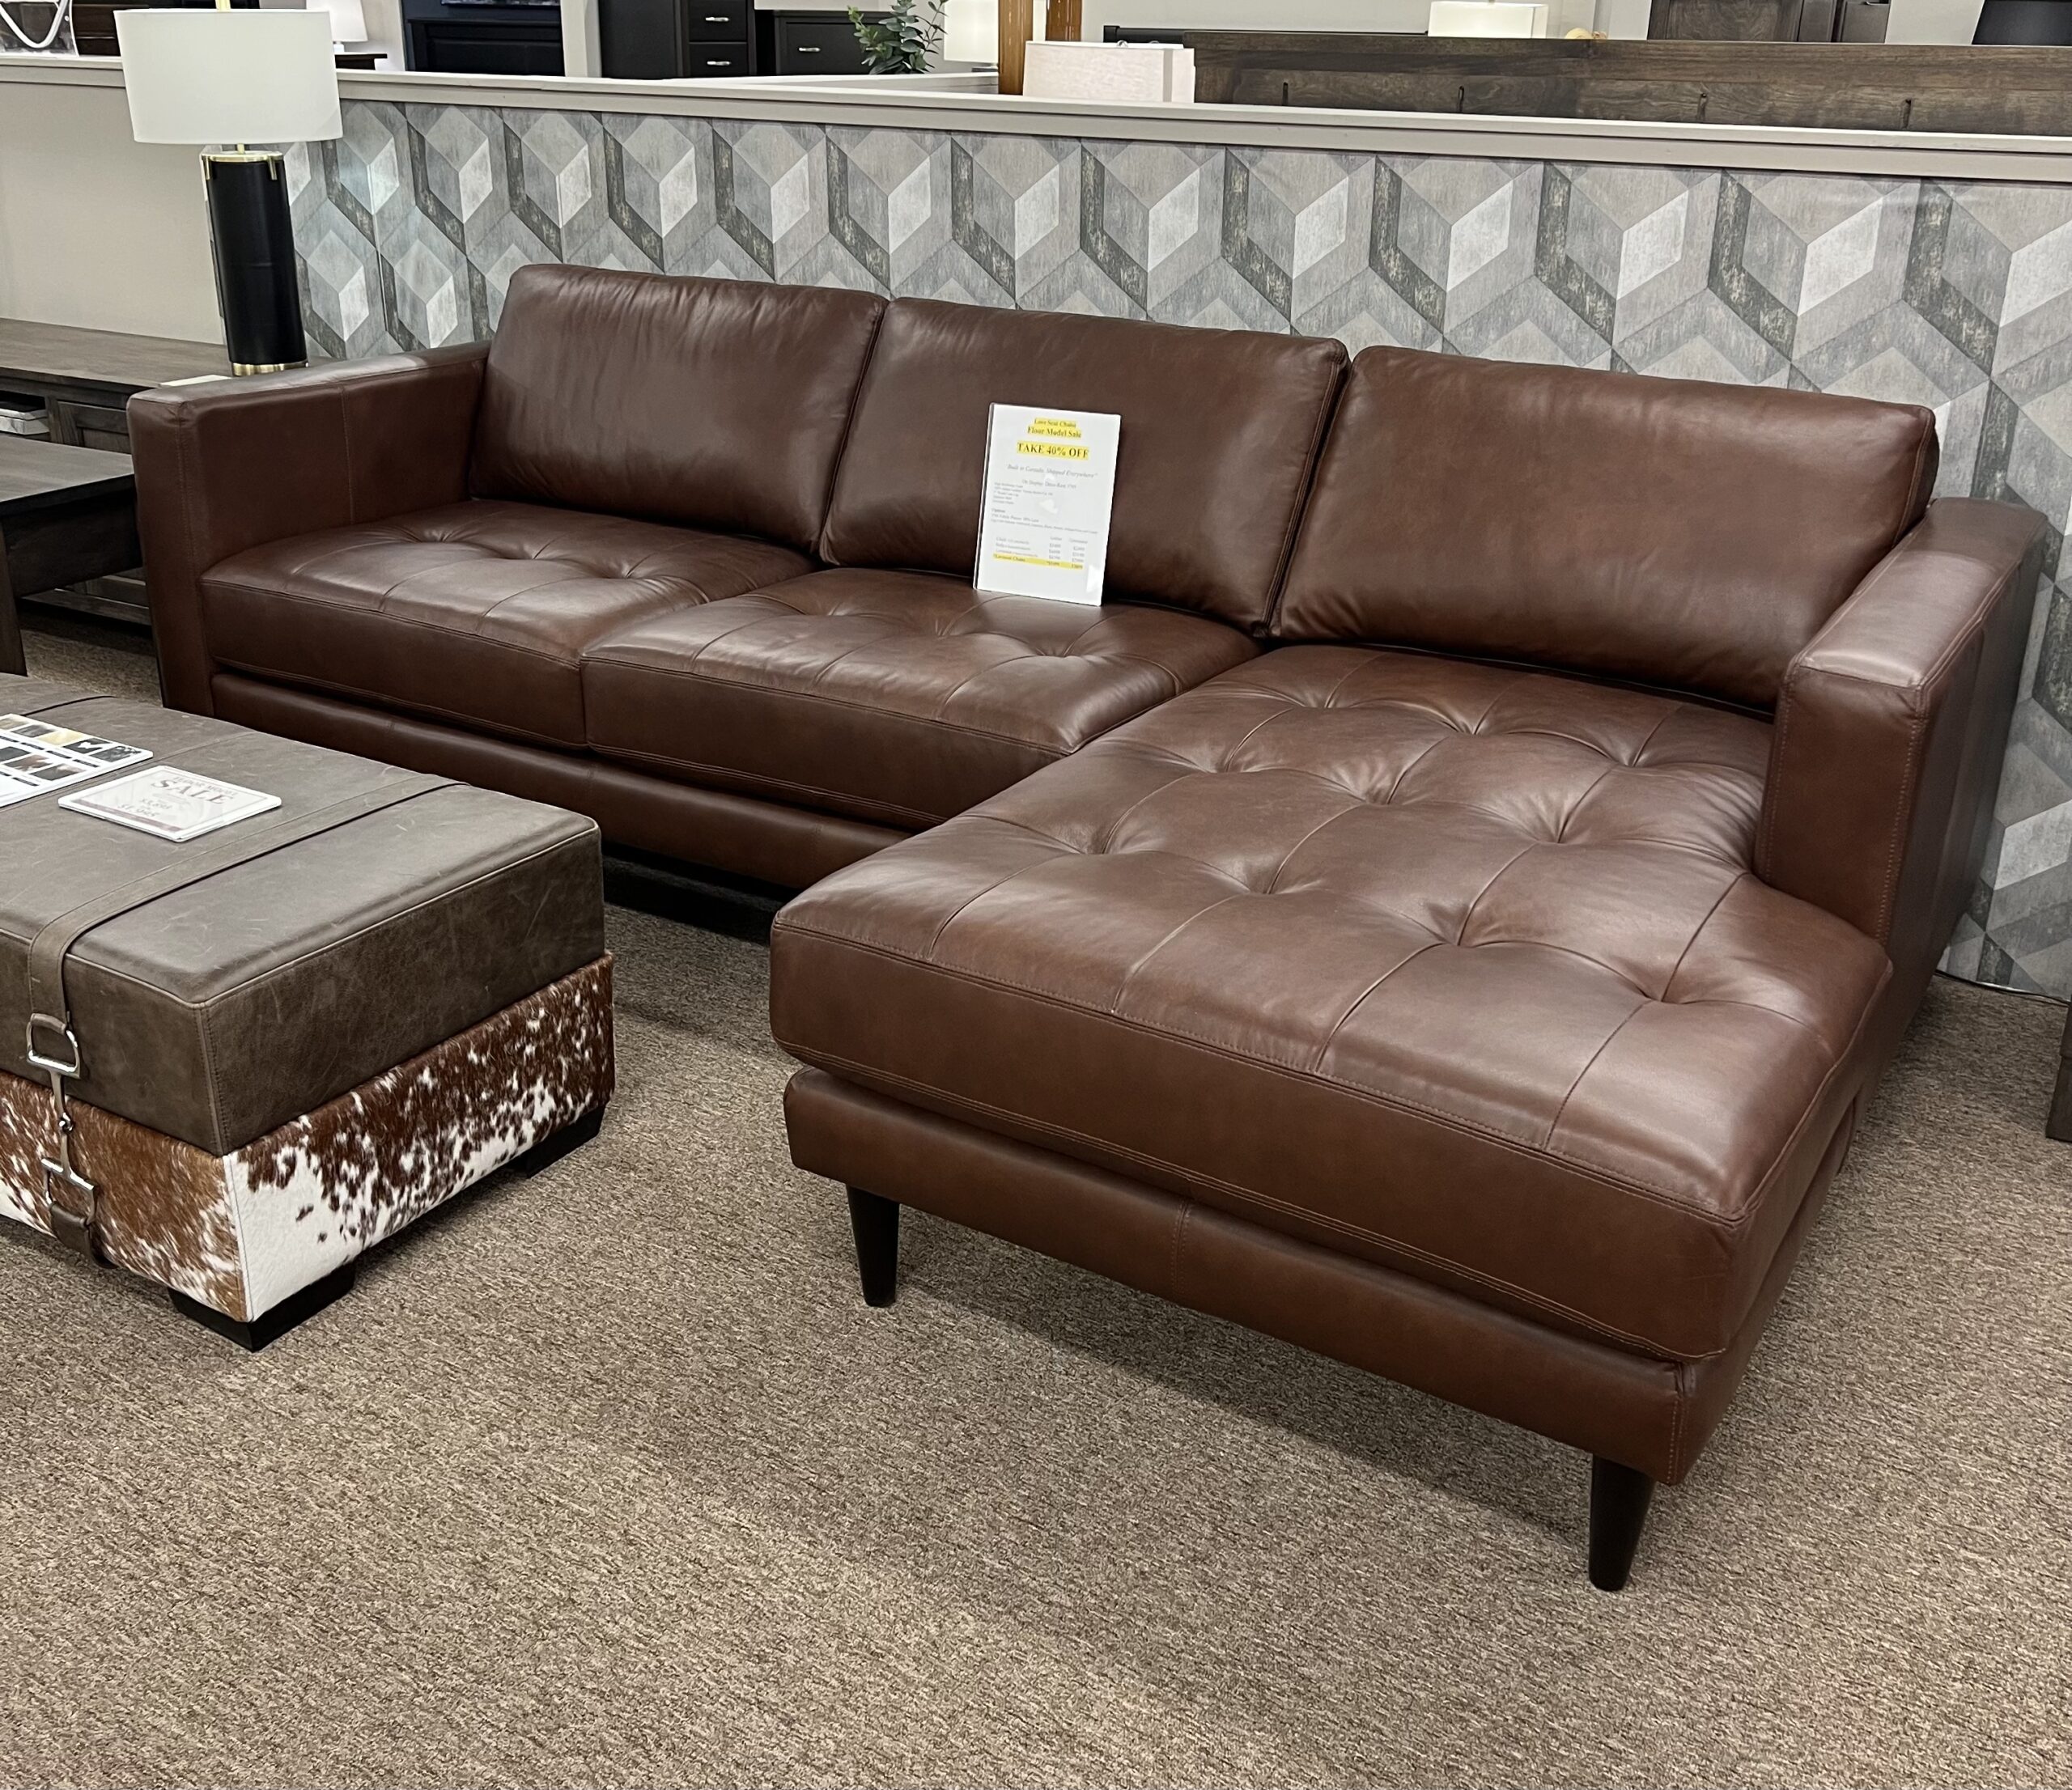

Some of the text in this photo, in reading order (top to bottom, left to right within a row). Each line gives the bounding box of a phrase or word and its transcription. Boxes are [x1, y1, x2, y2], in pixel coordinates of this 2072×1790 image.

[1027, 426, 1082, 438] Floor Model Sale
[1018, 443, 1089, 459] TAKE 40% OFF
[151, 779, 234, 804] SALE
